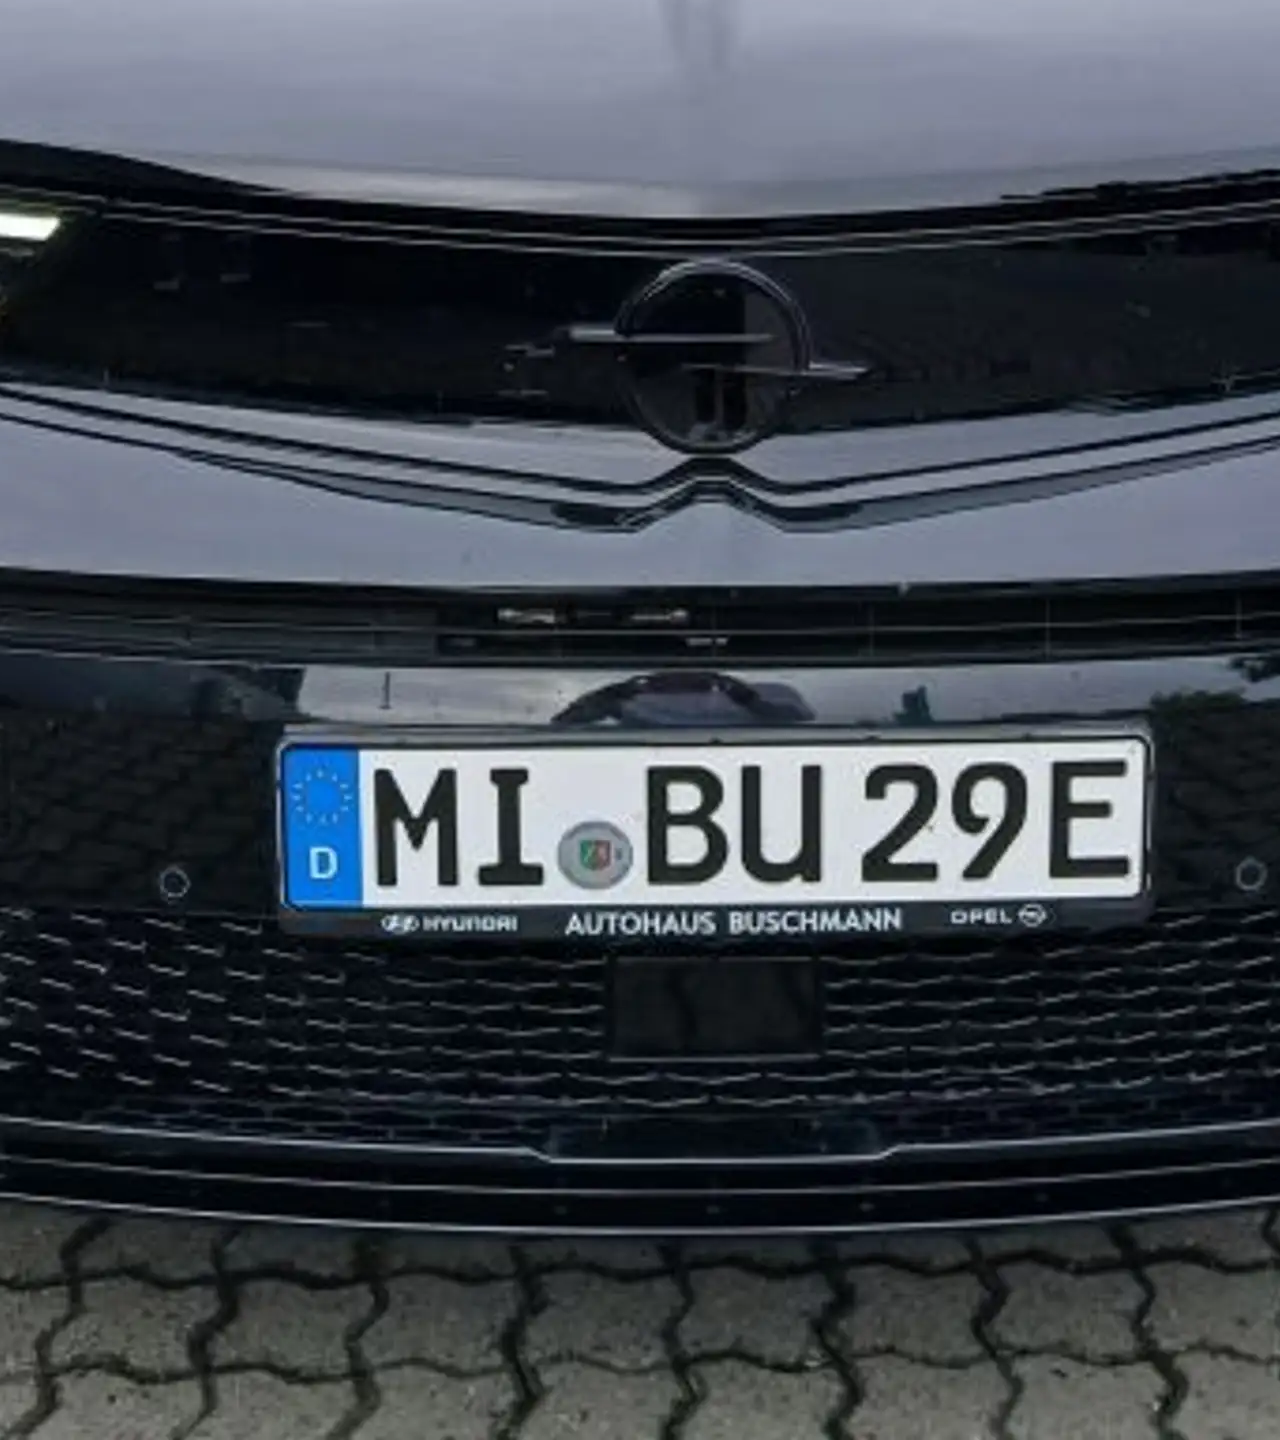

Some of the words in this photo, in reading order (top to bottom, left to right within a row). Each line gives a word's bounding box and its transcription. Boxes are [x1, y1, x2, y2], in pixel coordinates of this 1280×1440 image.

[372, 767, 545, 886] MI
[646, 764, 822, 885] BU
[860, 761, 1131, 883] 29E
[308, 846, 338, 880] D
[422, 916, 518, 933] HYUNDAI
[565, 910, 717, 936] AUTOHAUS
[728, 907, 903, 935] BUSCHMANN
[949, 910, 1012, 925] OPEL
